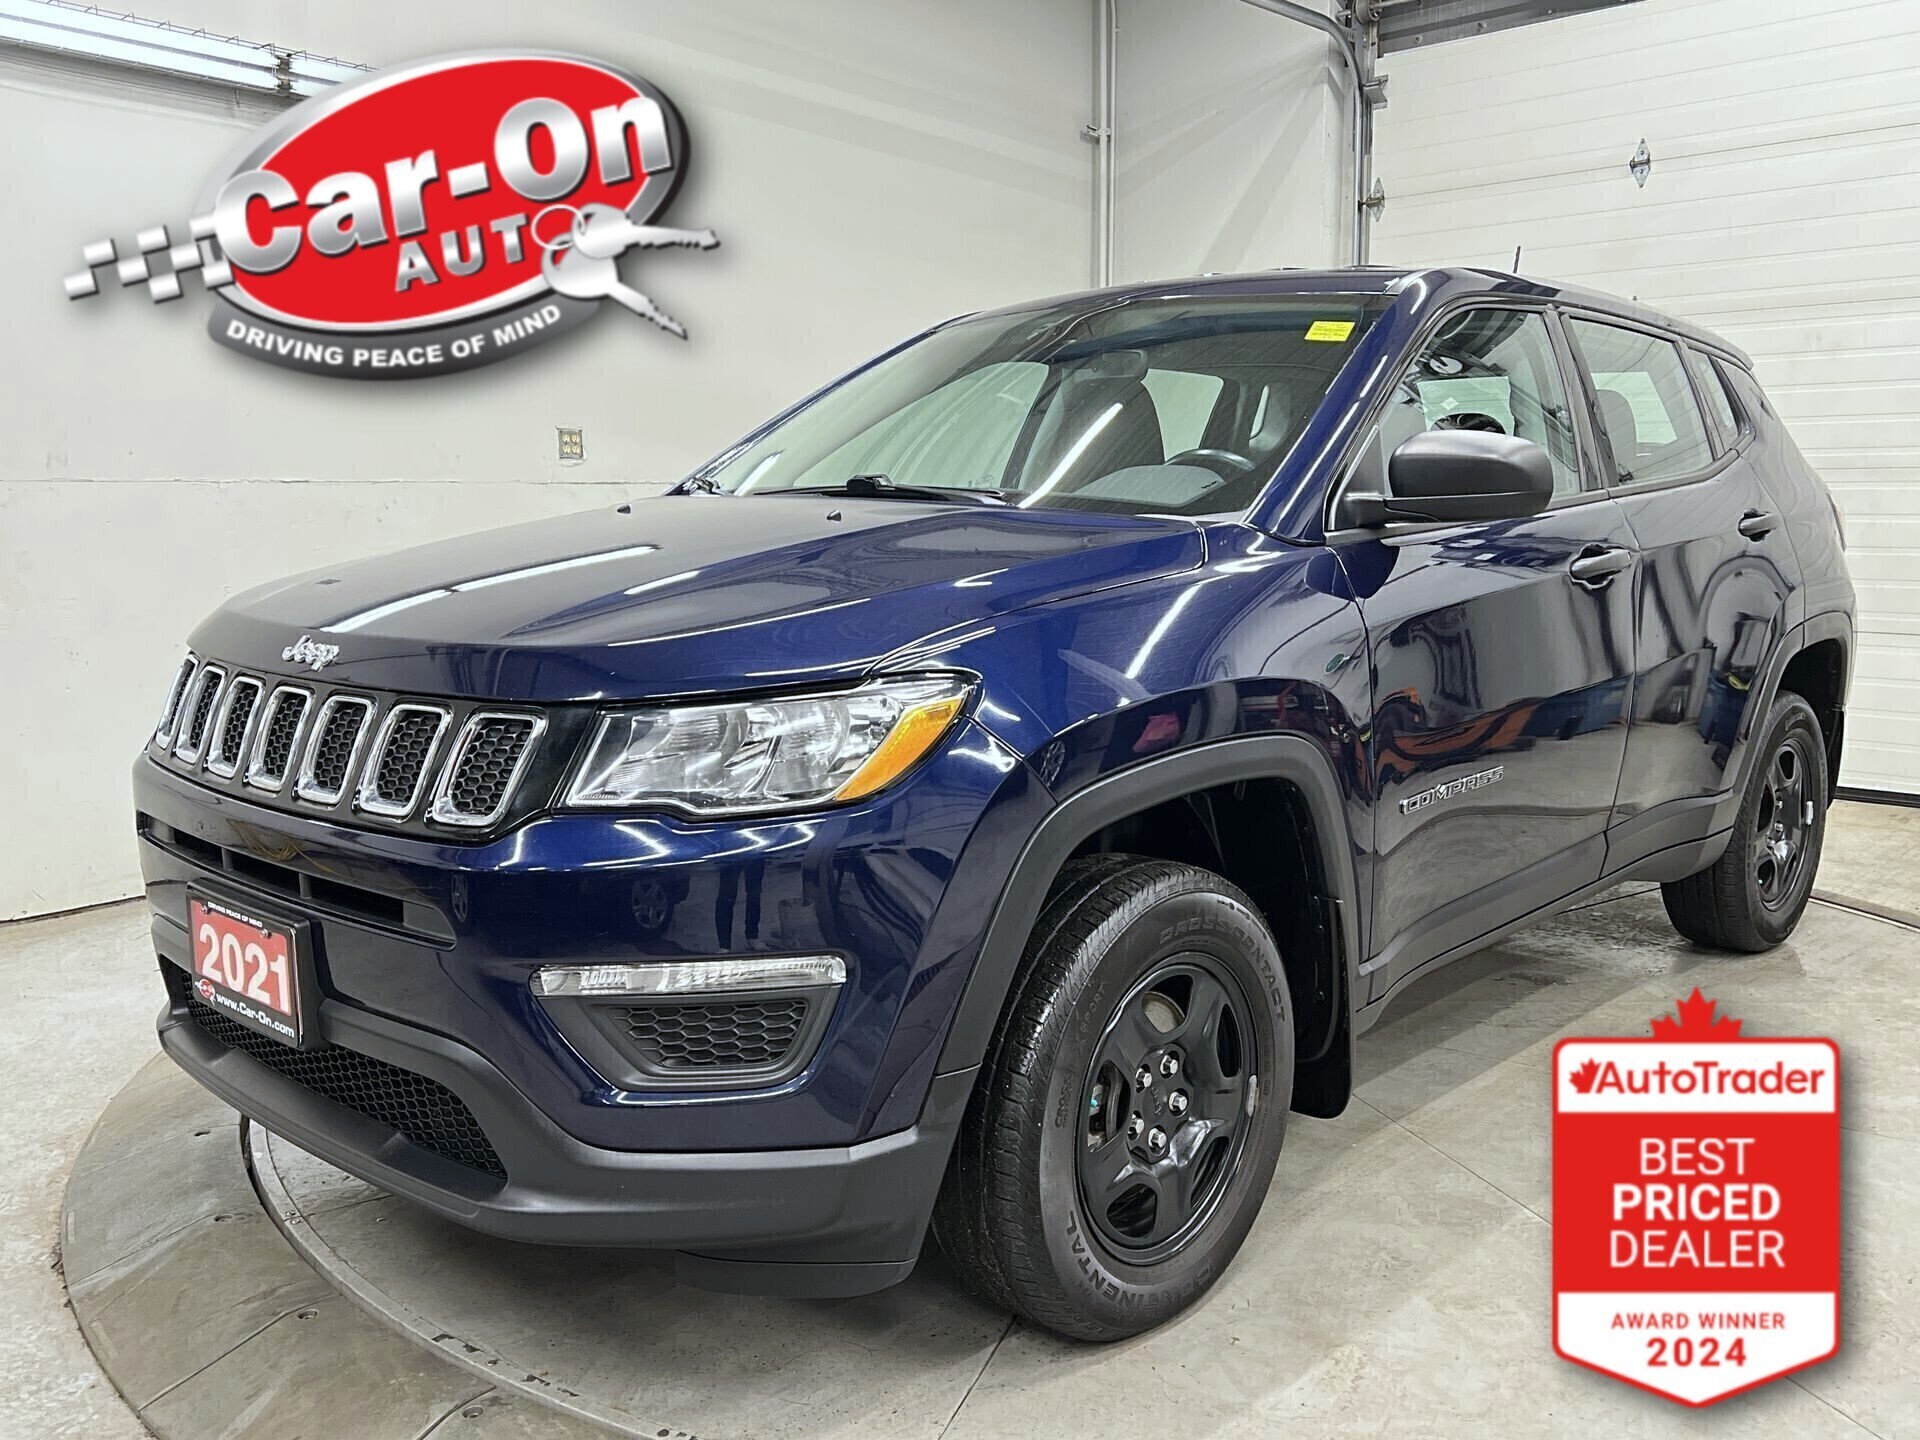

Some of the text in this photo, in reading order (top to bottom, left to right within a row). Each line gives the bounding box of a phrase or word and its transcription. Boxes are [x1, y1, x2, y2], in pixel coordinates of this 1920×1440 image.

[281, 634, 340, 672] Jeep
[1399, 766, 1504, 814] COMPASS
[200, 923, 290, 1013] 2021
[216, 993, 295, 1038] www.Car-On.com
